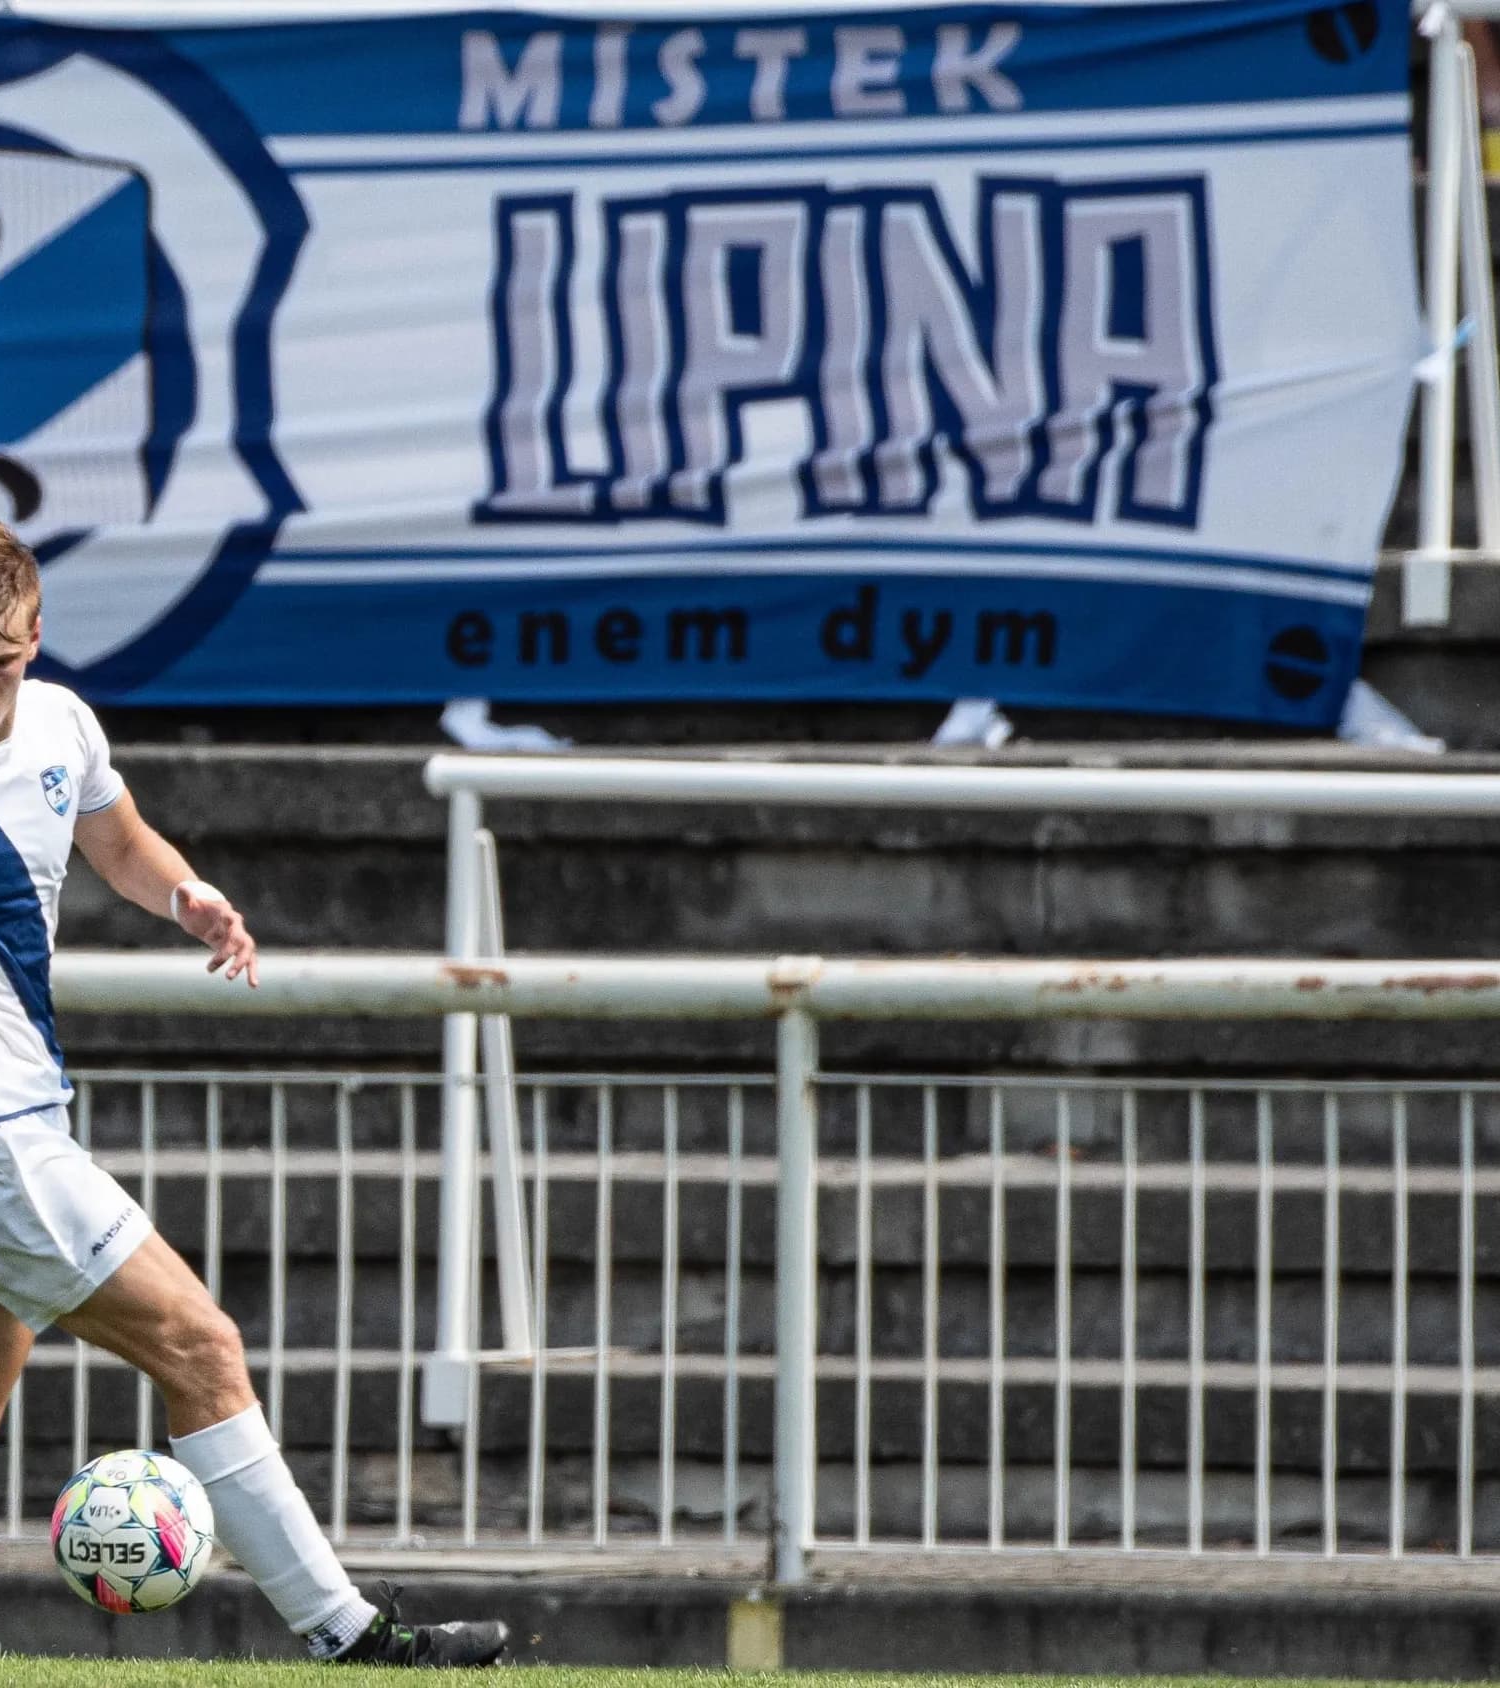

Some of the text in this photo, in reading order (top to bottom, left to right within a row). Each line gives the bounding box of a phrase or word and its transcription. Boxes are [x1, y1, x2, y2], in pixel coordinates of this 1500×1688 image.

[469, 172, 1219, 530] LIPINA
[445, 586, 1058, 678] enem dym
[68, 1537, 145, 1564] SELECT
